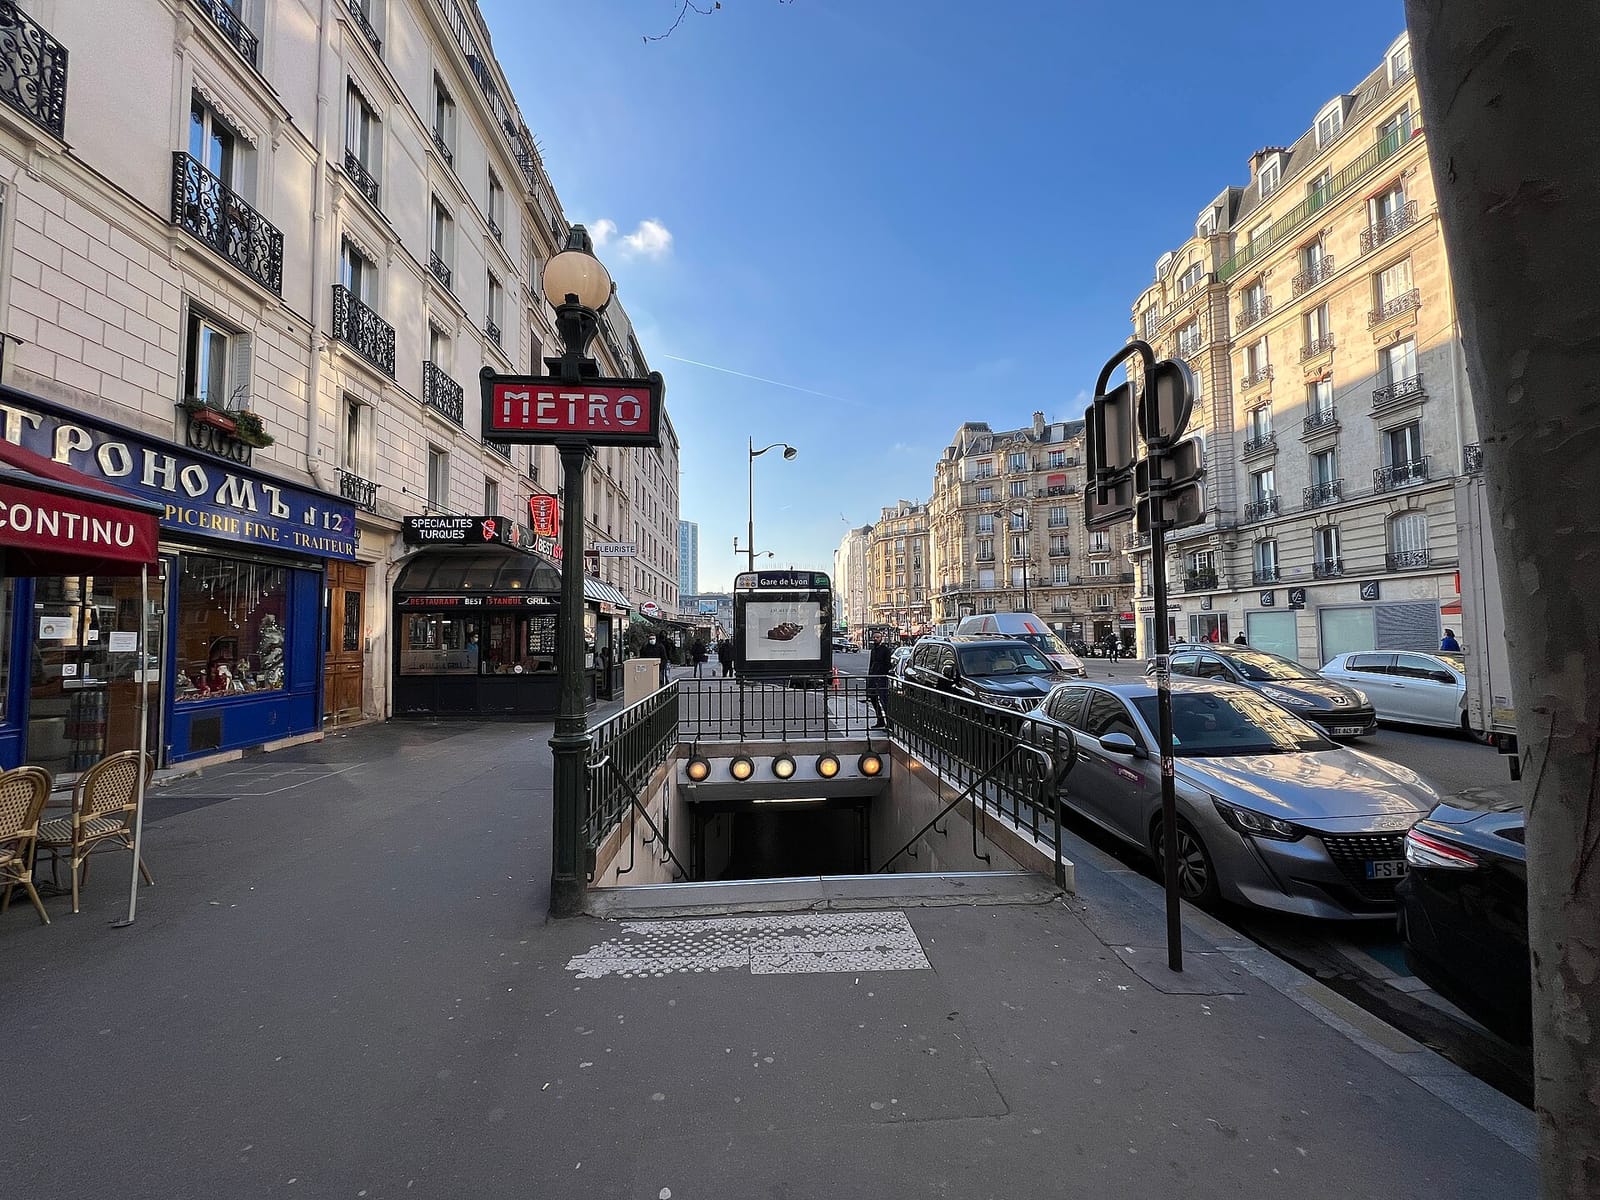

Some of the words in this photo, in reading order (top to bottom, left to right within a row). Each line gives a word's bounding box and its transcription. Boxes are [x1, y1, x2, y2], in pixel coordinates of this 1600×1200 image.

[503, 391, 641, 426] METRO
[322, 511, 343, 531] 12
[411, 518, 473, 528] SPECIALITES
[163, 504, 239, 534] PICERIE
[245, 521, 280, 541] FINE
[293, 531, 353, 555] TRAITEUR
[420, 529, 465, 539] TURQUES
[538, 538, 553, 556] BEST
[760, 578, 778, 586] Gare
[779, 578, 789, 586] de
[790, 578, 808, 587] Lyon
[410, 598, 459, 606] RESTAURANT
